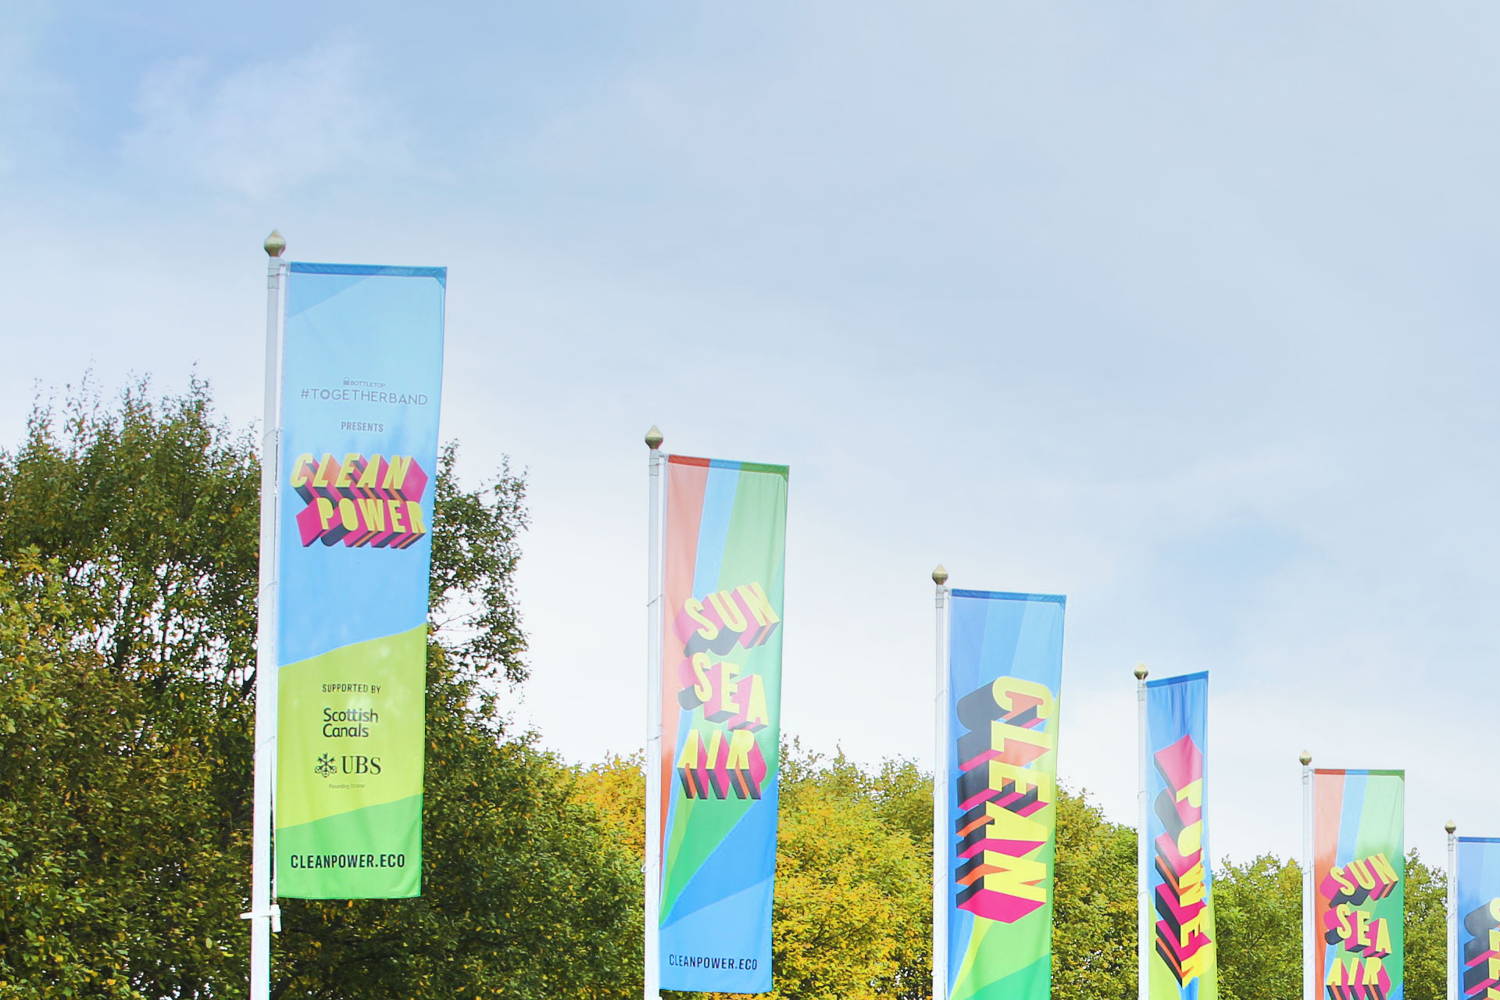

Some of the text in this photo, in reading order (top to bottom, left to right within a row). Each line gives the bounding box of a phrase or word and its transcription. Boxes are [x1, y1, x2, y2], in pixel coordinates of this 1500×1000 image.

[299, 388, 428, 406] #TOGETHERBAND
[340, 421, 384, 433] PRESENTS
[290, 453, 421, 496] CLEAN
[306, 497, 427, 541] POWER
[679, 582, 780, 648] SUN
[322, 683, 381, 694] SUPPORTED BY
[685, 652, 768, 729] SEA
[322, 723, 369, 738] Canals
[323, 707, 379, 723] Scottish
[342, 755, 382, 775] UBS
[677, 729, 761, 785] AIR
[971, 675, 1053, 916] CLEAN
[290, 853, 406, 869] CLEANPOWER.ECO
[1165, 756, 1212, 989] POWER
[1325, 853, 1399, 902] SUN
[1330, 903, 1392, 956] SEA
[668, 953, 758, 971] CLEANPOWER.ECO
[1326, 957, 1386, 996] AIR
